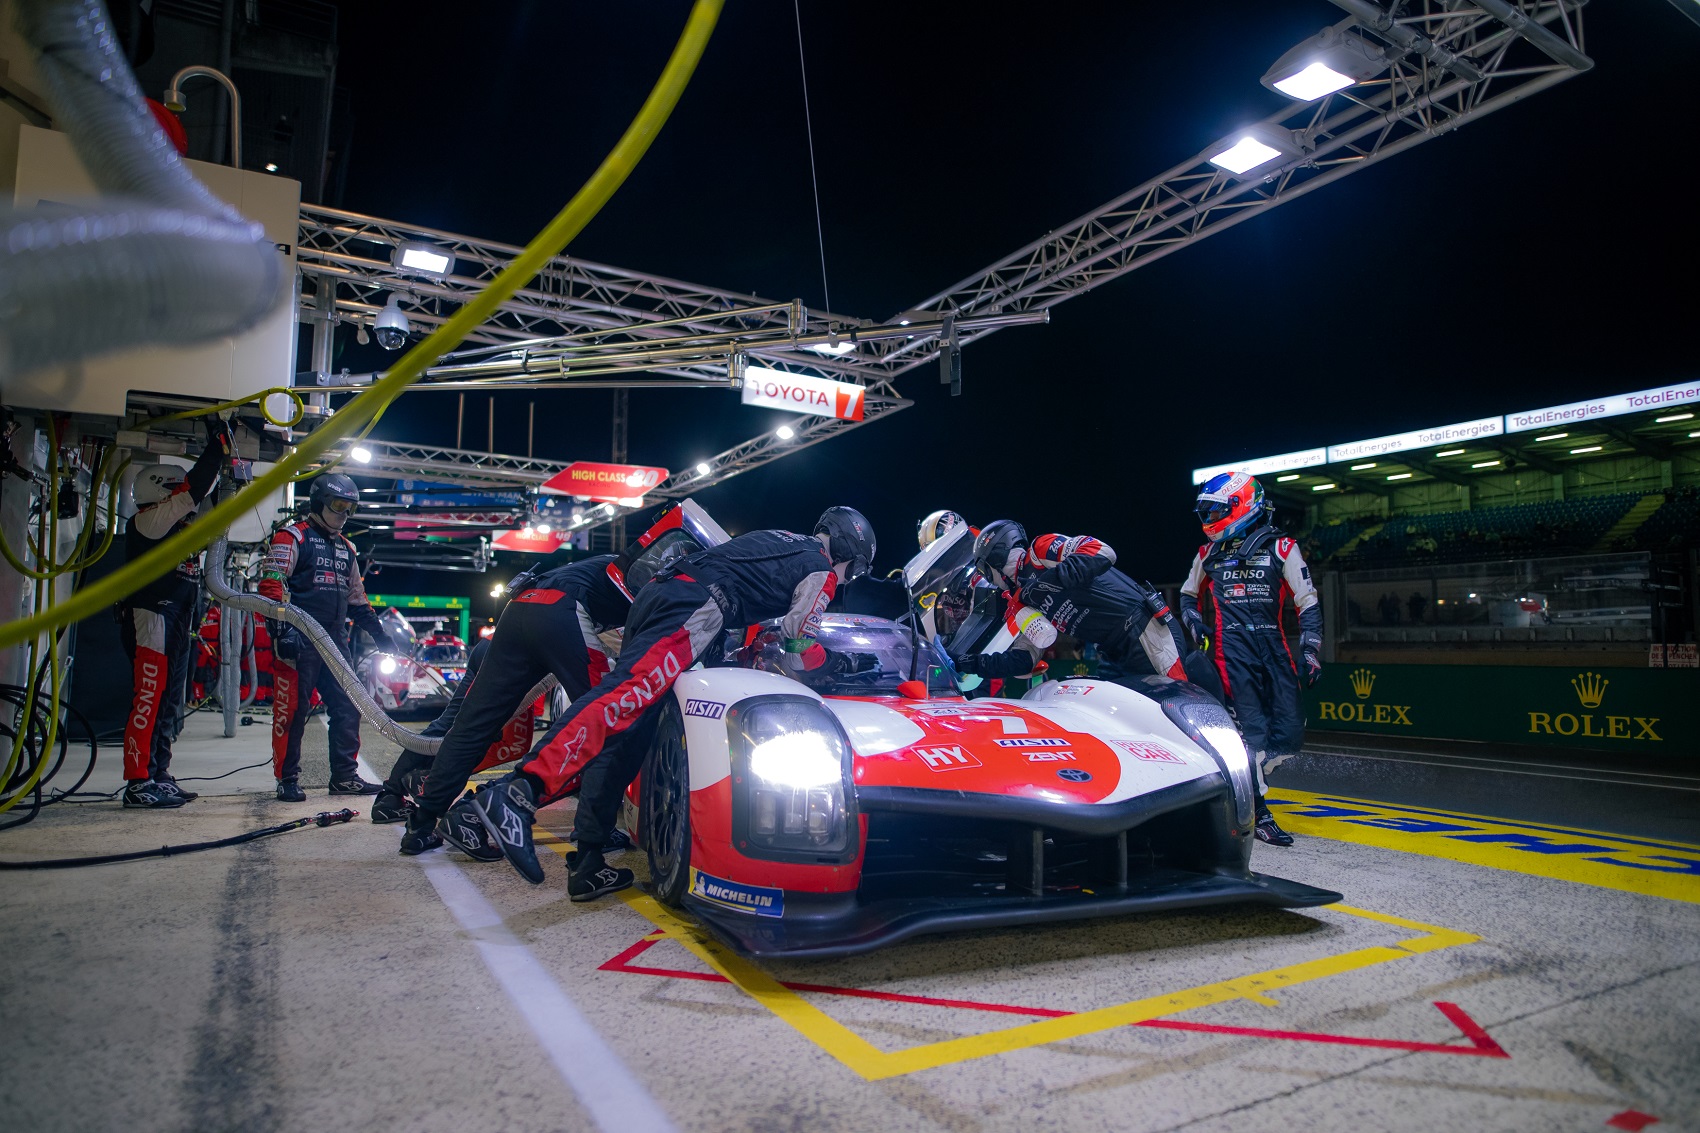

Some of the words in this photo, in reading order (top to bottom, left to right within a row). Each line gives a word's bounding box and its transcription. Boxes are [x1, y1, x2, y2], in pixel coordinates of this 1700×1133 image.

[752, 379, 830, 407] TOYOTA
[837, 386, 862, 418] 7
[1513, 404, 1606, 428] TotalEnergies
[1418, 423, 1497, 443] TotalEnergies
[1334, 440, 1403, 458] TotalEnergies
[572, 470, 596, 481] HIGH
[597, 471, 627, 483] CLASS
[1223, 569, 1265, 581] DENSO
[132, 662, 159, 730] DENSO
[603, 650, 681, 728] DENSO
[1083, 685, 1096, 696] 7
[273, 676, 290, 738] DENSO
[686, 701, 725, 718] AISIN
[1319, 701, 1413, 726] ROLEX
[1527, 711, 1664, 741] ROLEX
[999, 739, 1067, 747] AISIN
[1116, 741, 1165, 750] HYPER
[916, 746, 968, 767] HY
[1020, 751, 1078, 763] ZENT
[1129, 747, 1177, 761] CAR
[706, 882, 773, 908] MICHELIN
